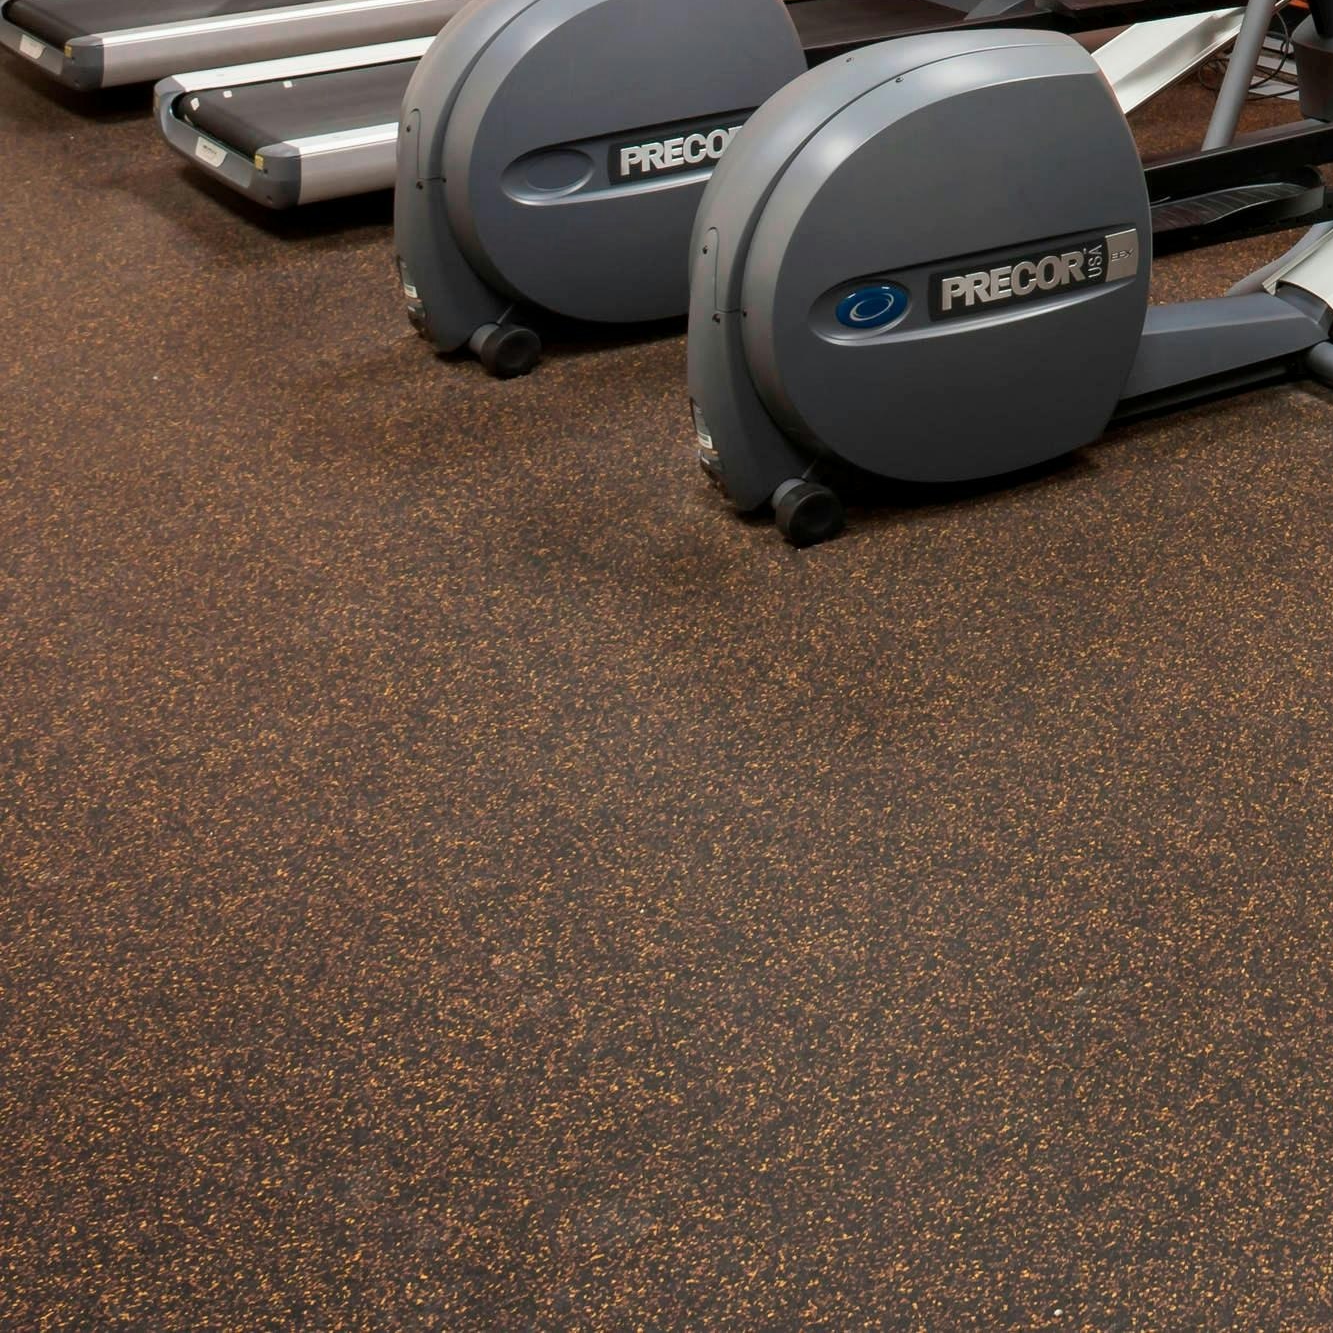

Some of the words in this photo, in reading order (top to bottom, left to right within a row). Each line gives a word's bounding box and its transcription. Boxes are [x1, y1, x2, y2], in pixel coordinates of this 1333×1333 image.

[620, 125, 743, 177] PRECO
[941, 250, 1087, 311] PRECOR
[1087, 244, 1103, 279] USA
